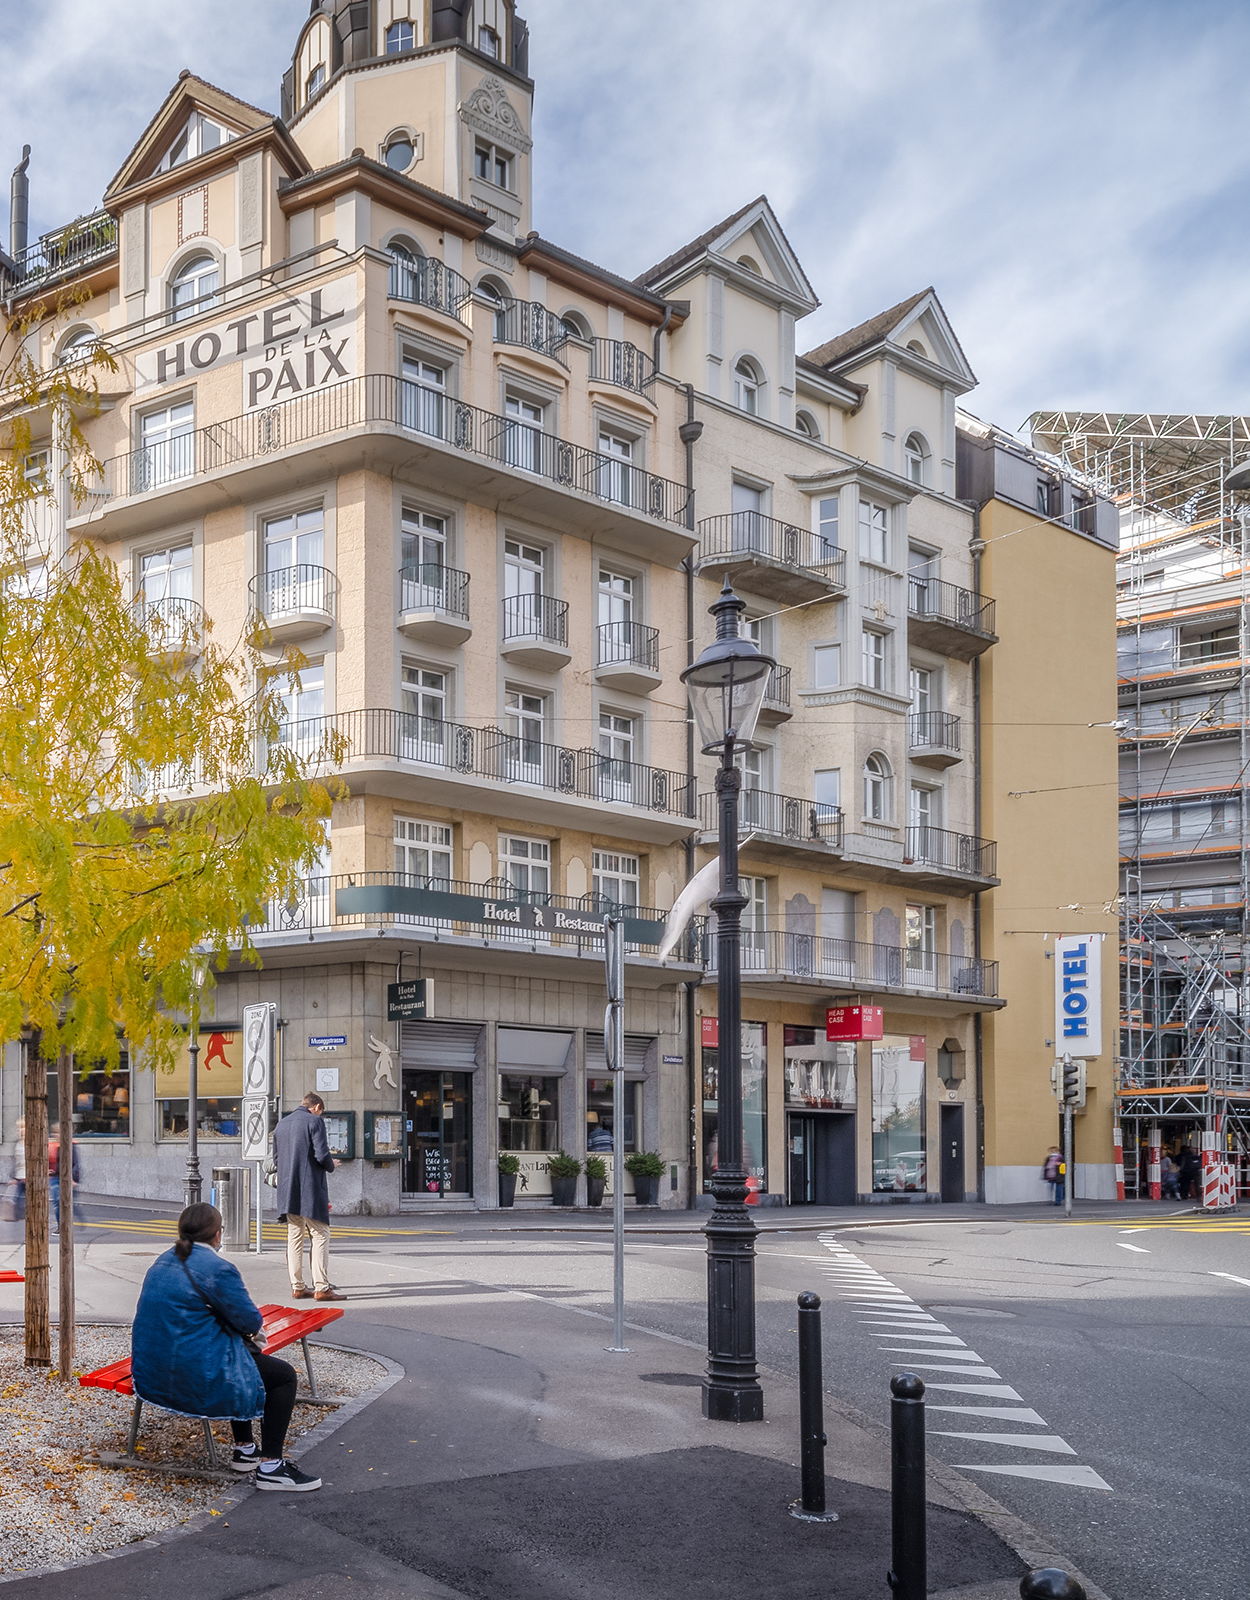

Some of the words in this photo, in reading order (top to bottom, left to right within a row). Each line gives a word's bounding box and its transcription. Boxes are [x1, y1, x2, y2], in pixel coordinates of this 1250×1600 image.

[157, 289, 345, 384] HOTEL
[265, 340, 293, 362] DE
[303, 328, 332, 349] LA
[248, 337, 350, 408] PAIX
[483, 902, 521, 922] Hotel
[554, 911, 605, 933] Restaura
[398, 984, 416, 995] Hotel
[1062, 942, 1088, 1037] HOTEL
[389, 1000, 425, 1012] Restaurant
[251, 1010, 262, 1019] ZONE
[828, 1016, 844, 1024] CASE
[250, 1103, 261, 1111] ZONE
[535, 1161, 551, 1174] Lap
